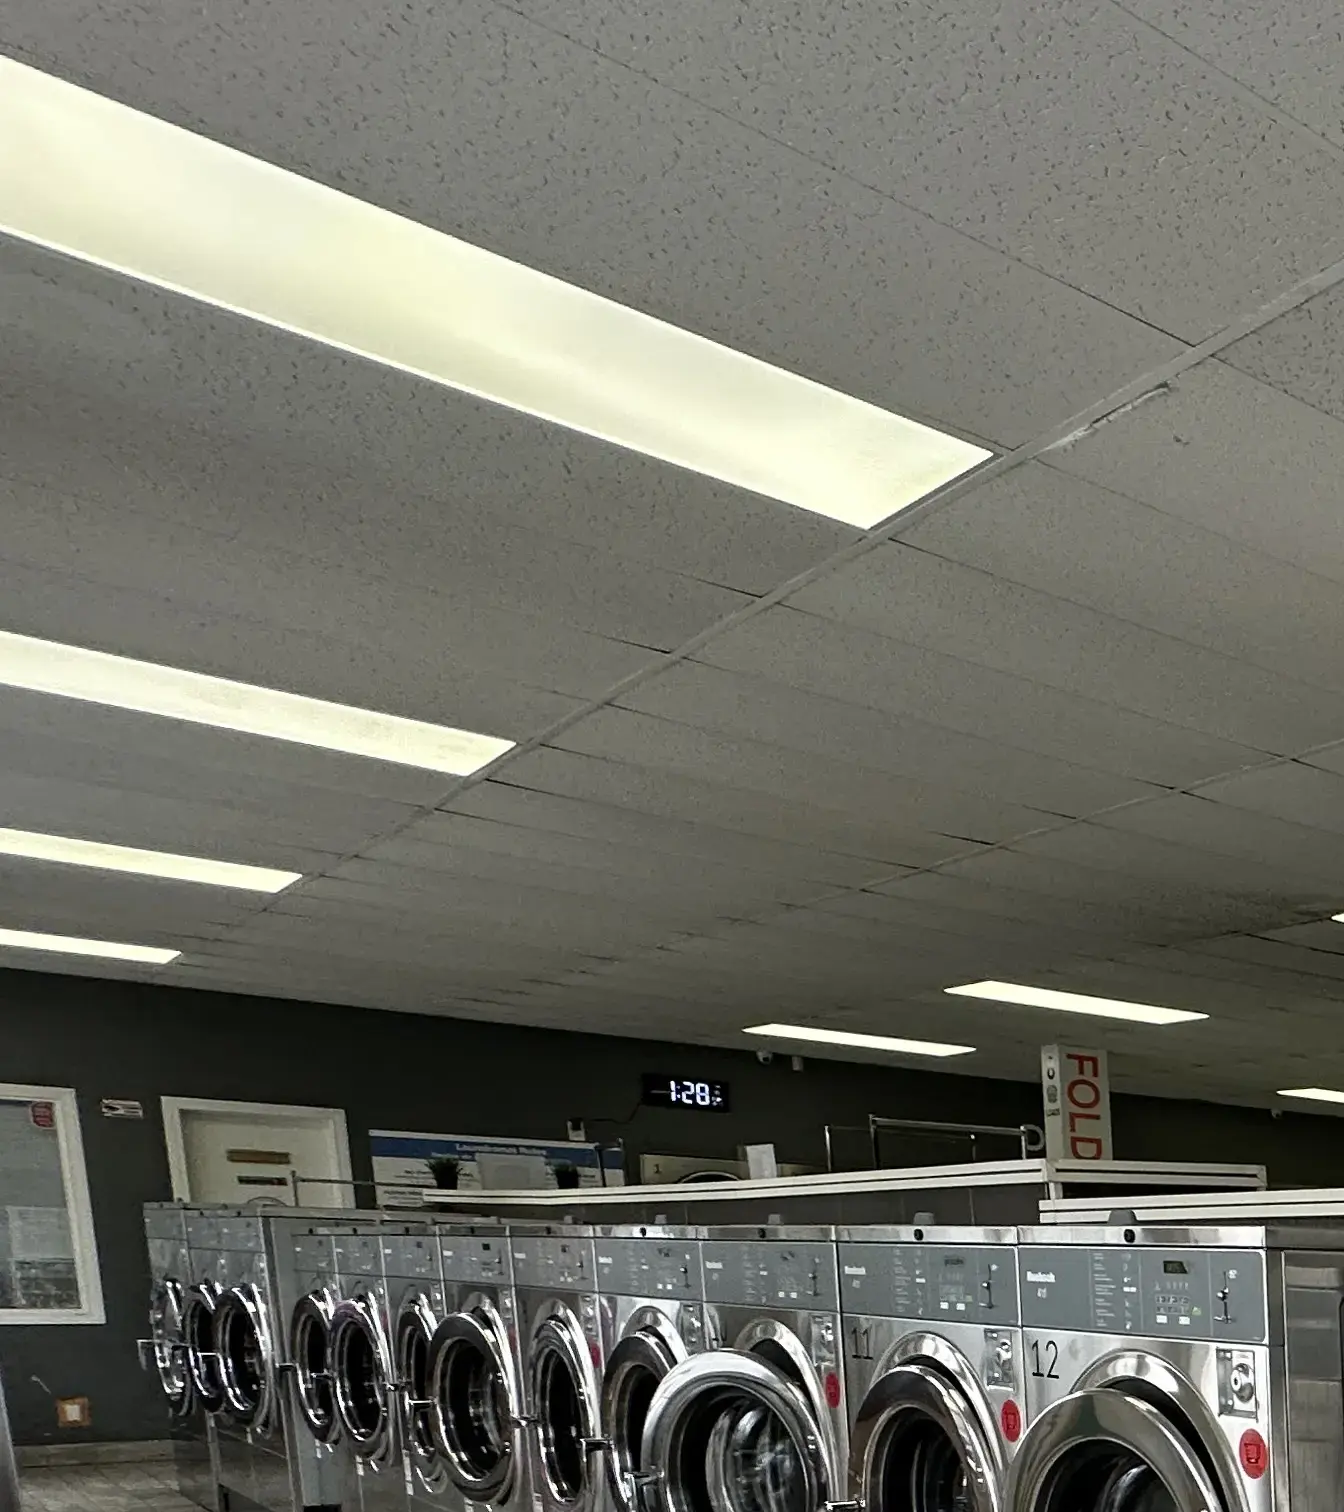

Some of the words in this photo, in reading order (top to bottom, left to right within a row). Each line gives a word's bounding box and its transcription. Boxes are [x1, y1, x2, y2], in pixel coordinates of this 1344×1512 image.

[670, 1080, 710, 1105] 1:28
[1066, 1053, 1102, 1160] FOLD
[852, 1327, 873, 1360] 11
[1032, 1340, 1059, 1379] 12
